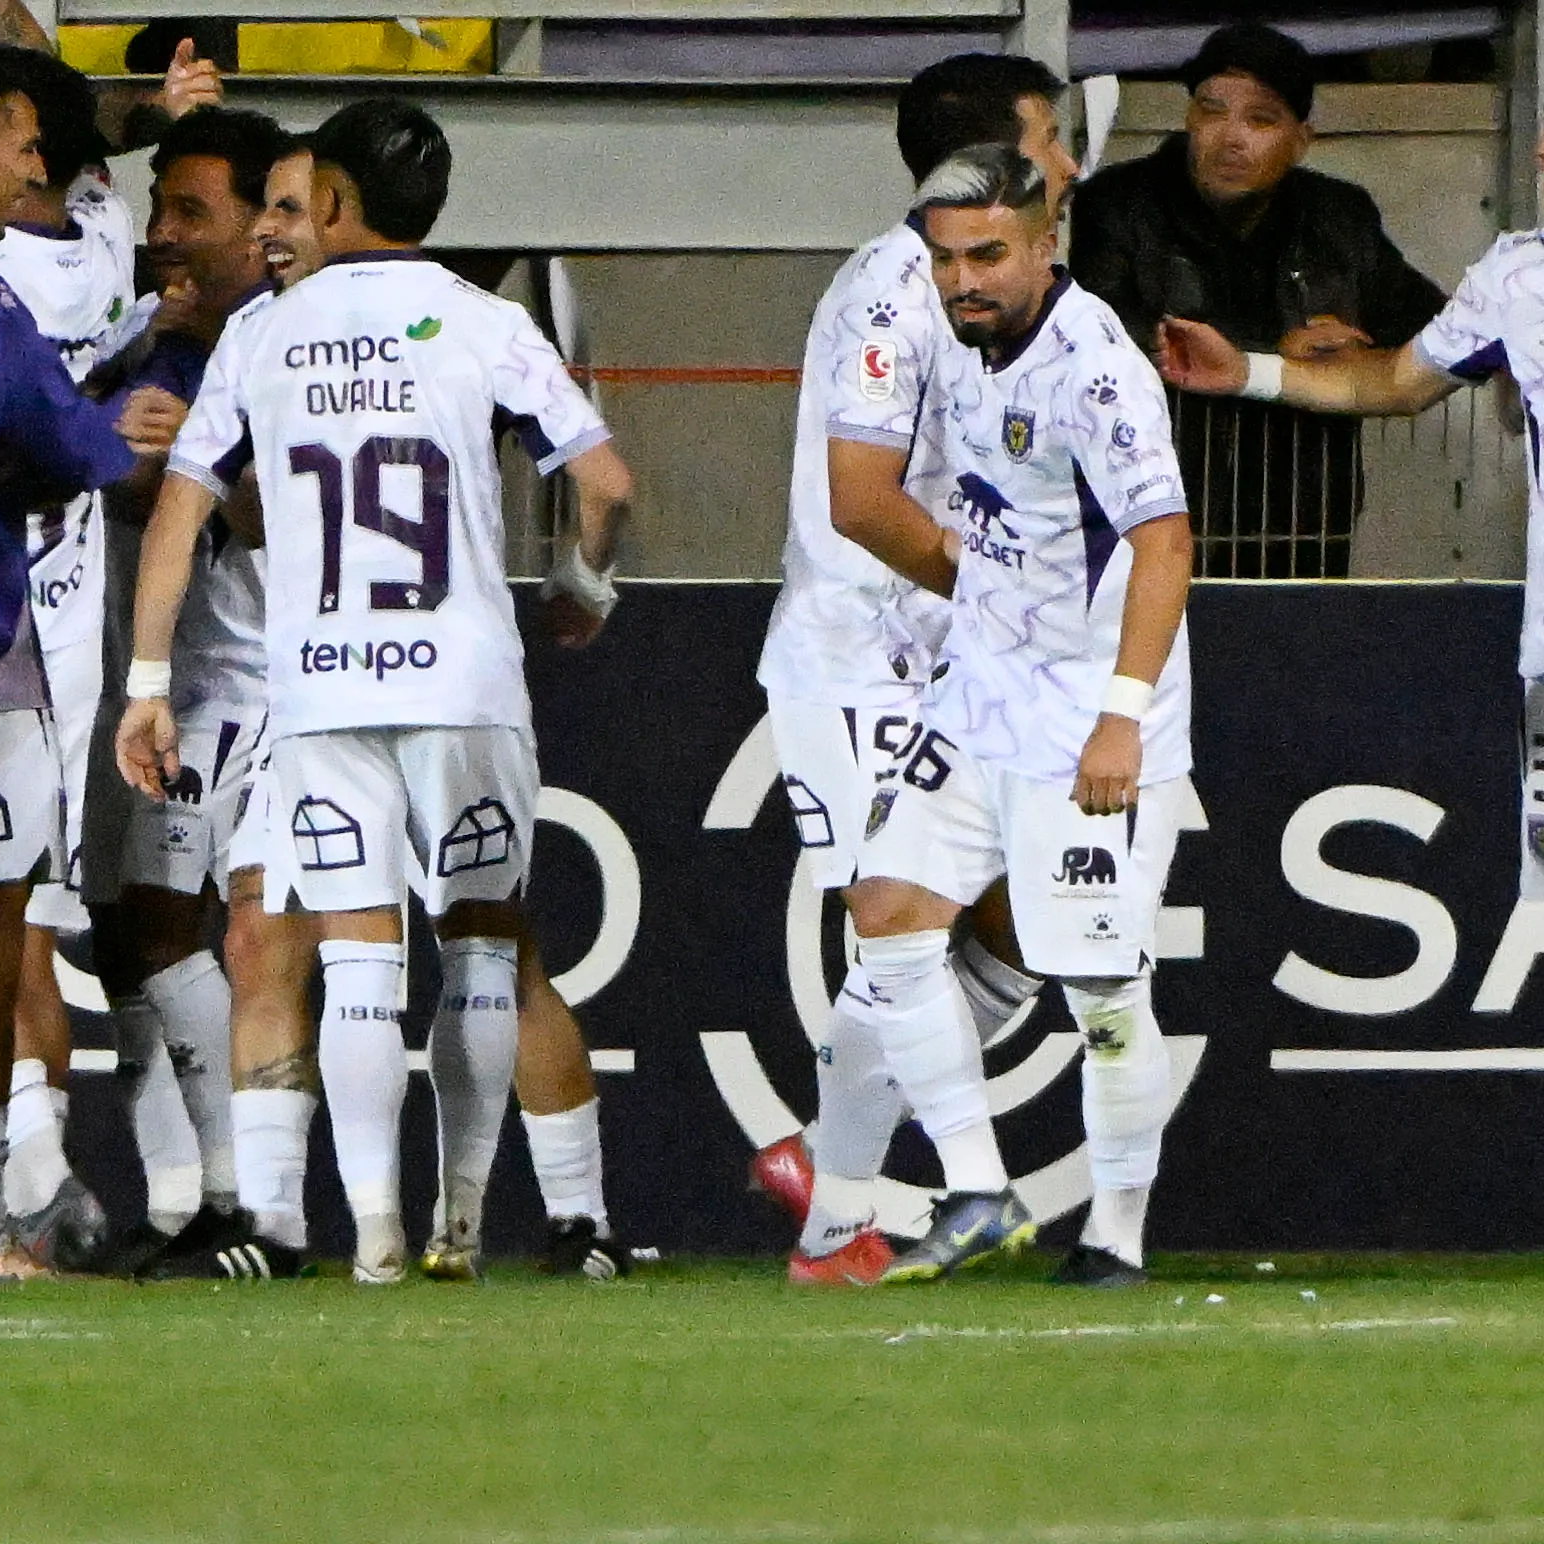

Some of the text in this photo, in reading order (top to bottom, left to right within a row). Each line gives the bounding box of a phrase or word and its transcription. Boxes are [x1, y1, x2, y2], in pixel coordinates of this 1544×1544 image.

[285, 333, 400, 371] cmpc
[306, 379, 416, 415] OVALLE
[288, 434, 450, 615] 19
[300, 638, 438, 681] tenpo
